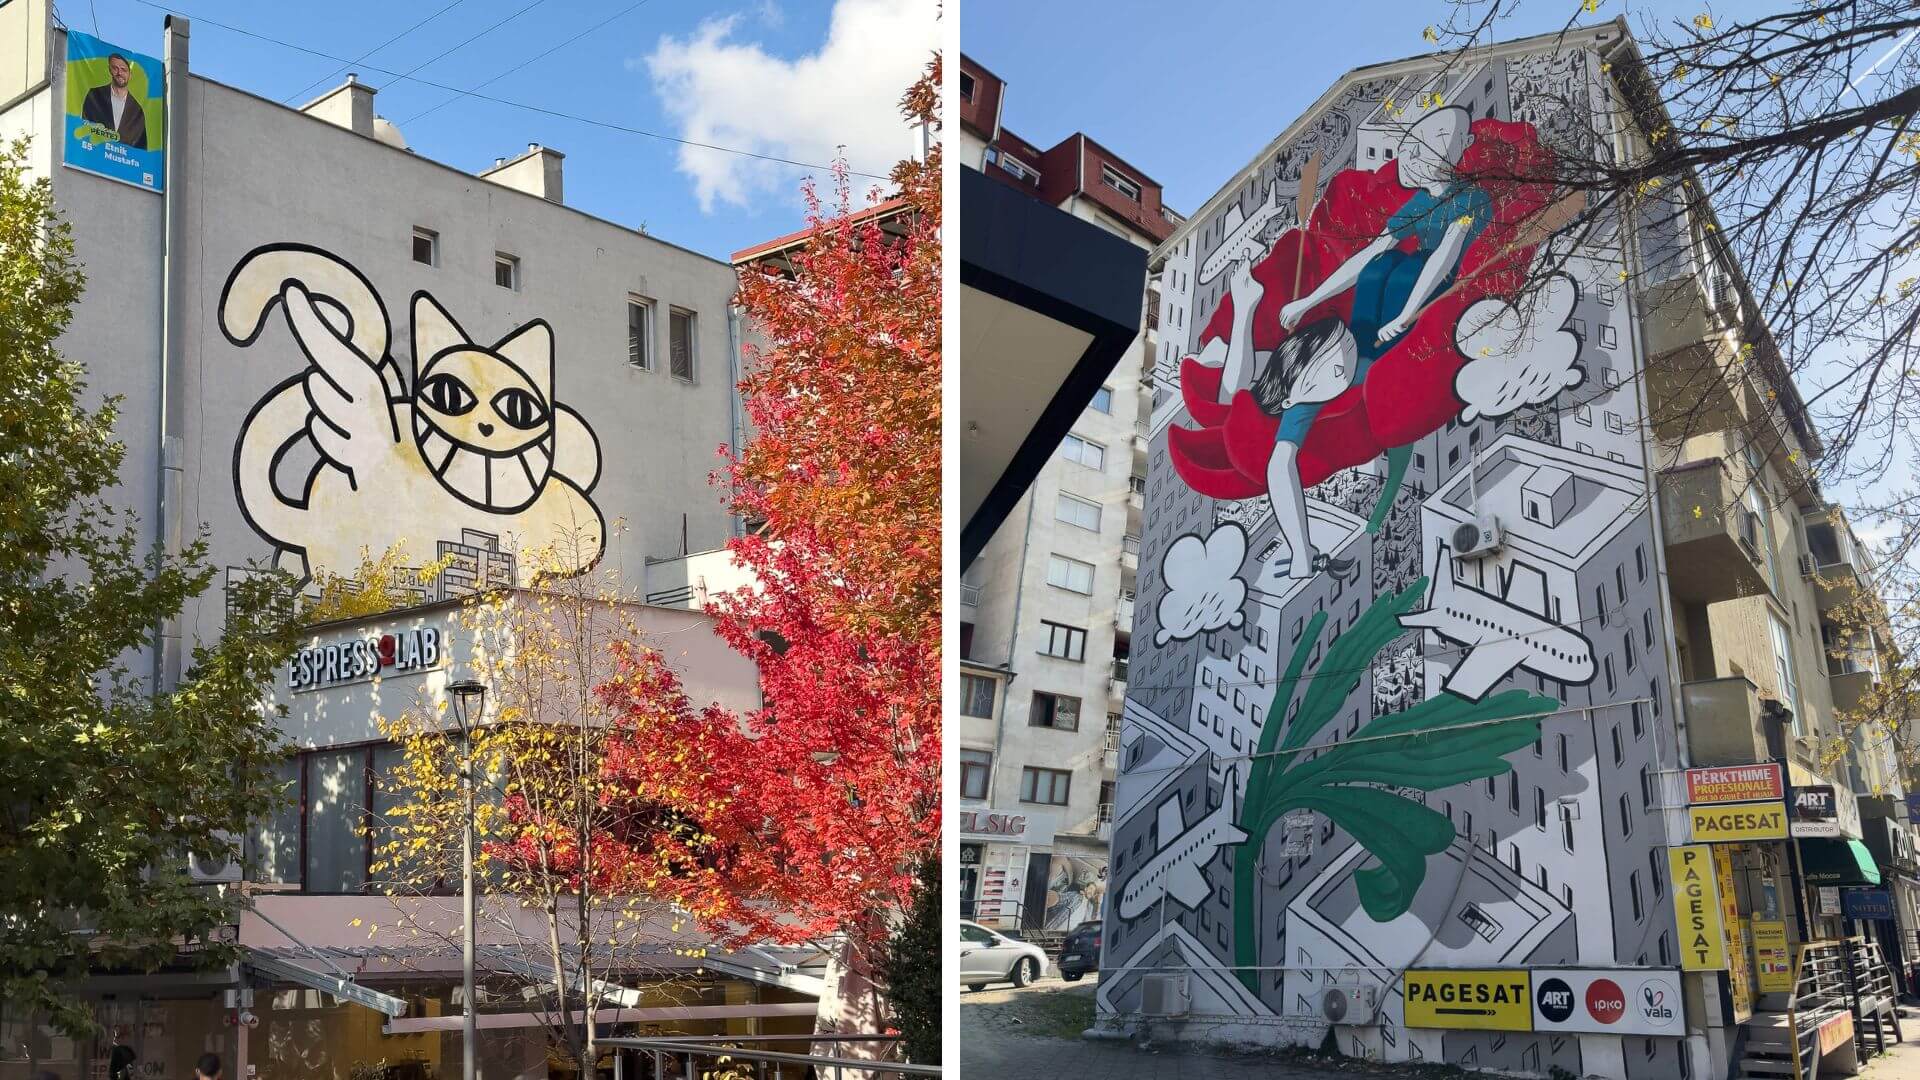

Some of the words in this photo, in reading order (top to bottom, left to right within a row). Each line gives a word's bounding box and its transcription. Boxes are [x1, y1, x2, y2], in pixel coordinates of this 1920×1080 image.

[105, 143, 127, 156] Etnik
[104, 151, 140, 167] Mustafa
[1693, 768, 1773, 784] PËRKTHIME
[1694, 781, 1774, 794] PROFESIONALE
[1794, 792, 1830, 807] ART
[1694, 812, 1781, 832] PAGESAT
[1683, 851, 1710, 965] PAGESAT
[1408, 982, 1525, 1004] PAGESAT
[1541, 991, 1570, 1005] ART
[1644, 1004, 1673, 1018] vala
